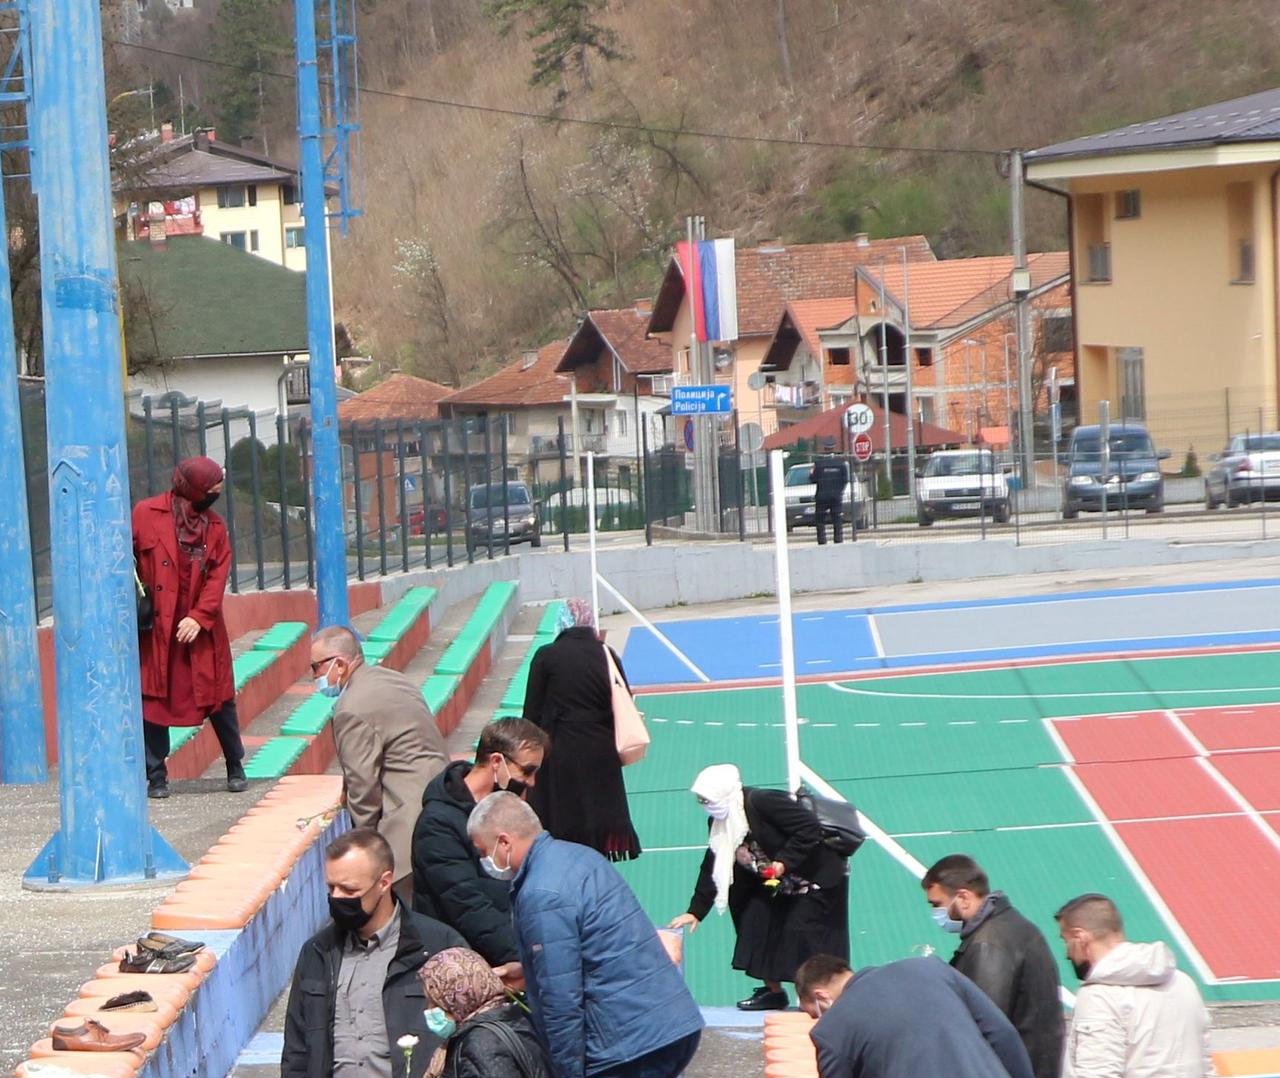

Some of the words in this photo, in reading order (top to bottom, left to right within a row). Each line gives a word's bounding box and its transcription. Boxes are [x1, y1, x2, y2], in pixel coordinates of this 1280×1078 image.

[675, 389, 715, 401] Полиција
[675, 401, 706, 413] Policija
[855, 441, 870, 453] STOP
